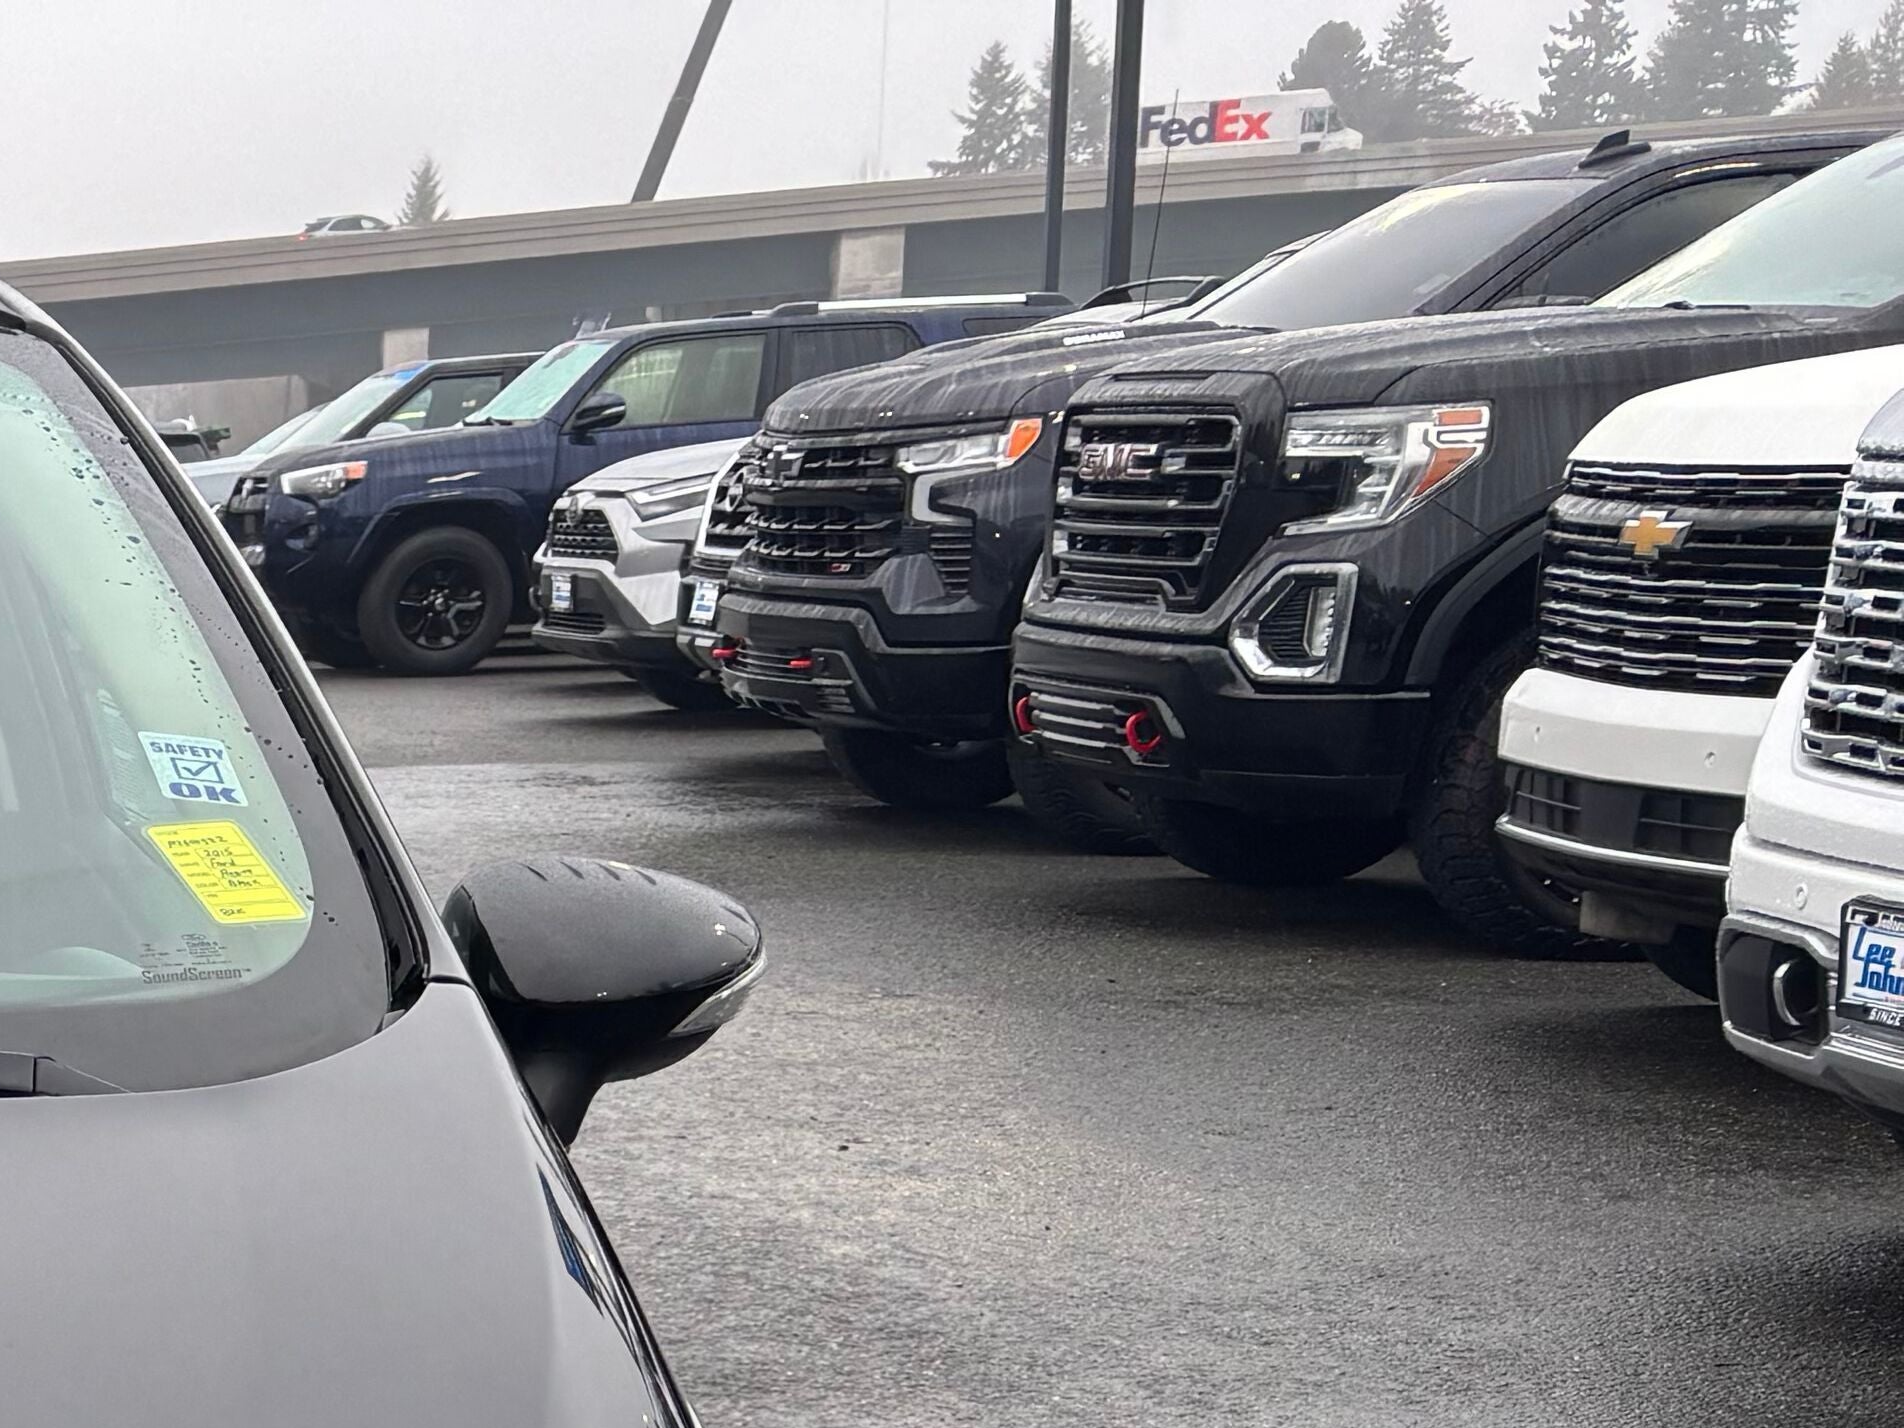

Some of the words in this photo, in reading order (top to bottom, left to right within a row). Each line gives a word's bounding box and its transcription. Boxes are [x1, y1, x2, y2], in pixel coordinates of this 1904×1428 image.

[1141, 99, 1272, 148] FedEx
[1078, 442, 1160, 481] GMC
[149, 741, 224, 760] SAFETY
[169, 782, 243, 804] OK
[1852, 926, 1896, 967] Lee
[142, 967, 243, 985] SoundScreen
[1869, 1007, 1901, 1026] SINCE
